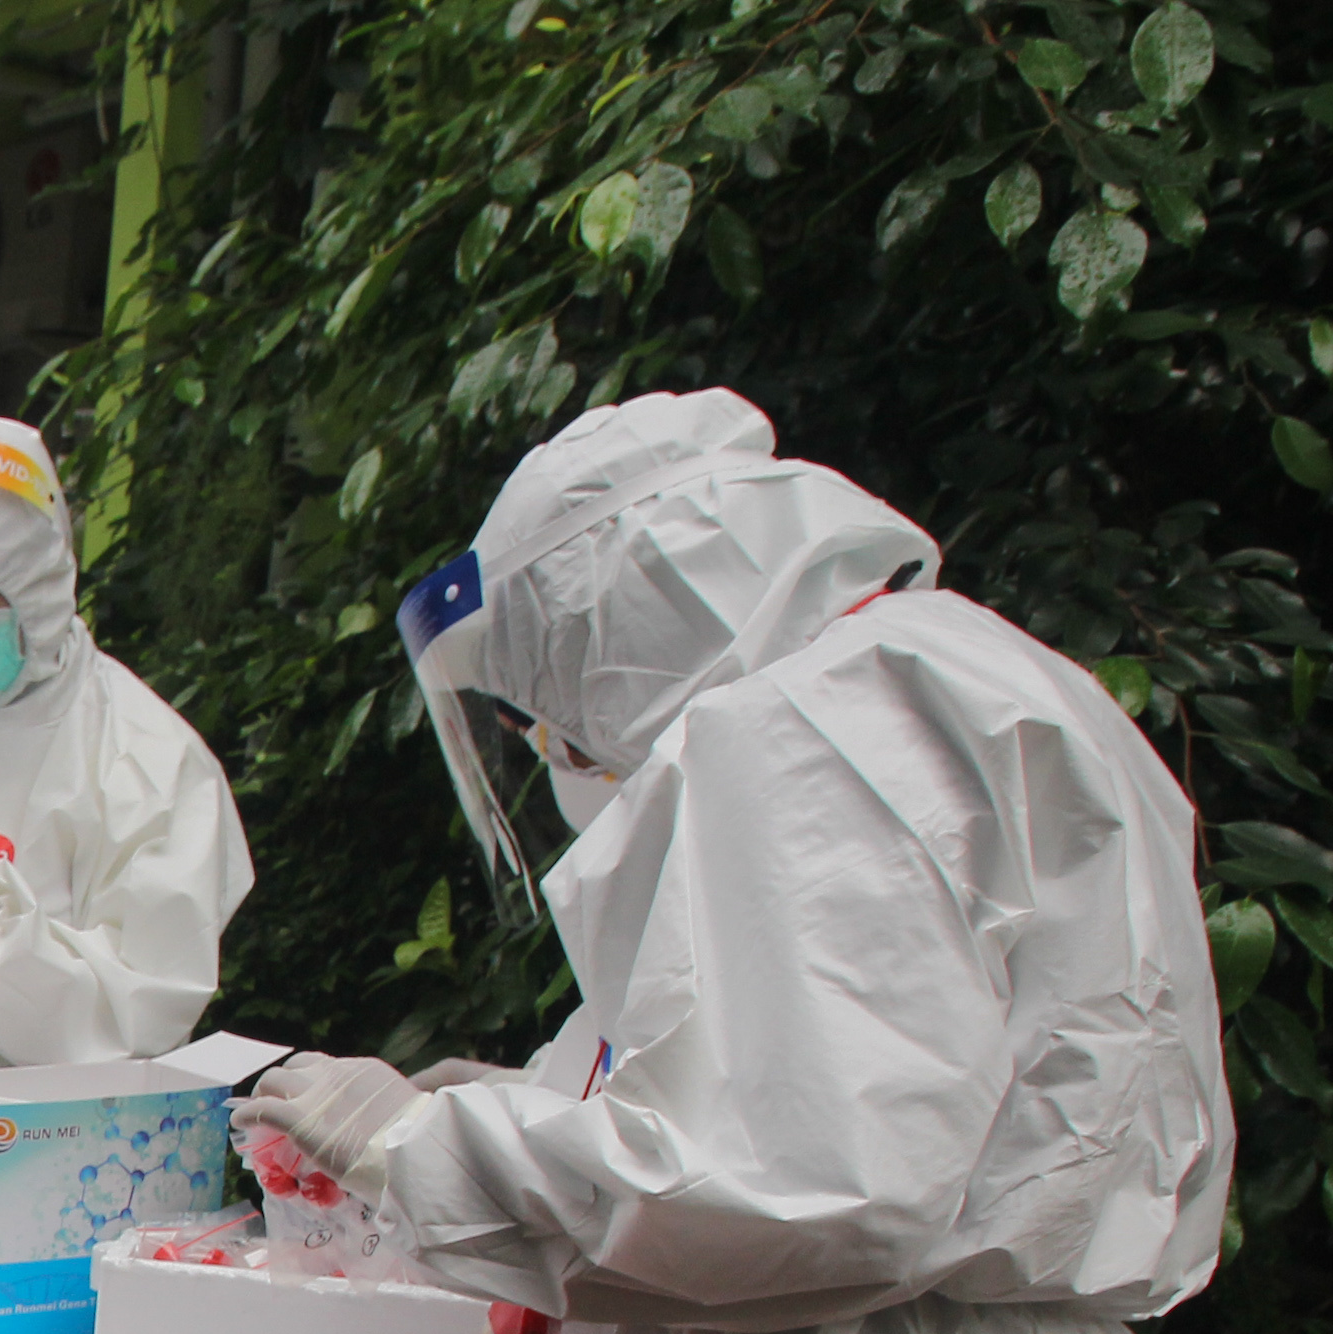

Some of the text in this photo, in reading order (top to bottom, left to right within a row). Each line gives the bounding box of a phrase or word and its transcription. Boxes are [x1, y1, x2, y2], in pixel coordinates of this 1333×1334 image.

[23, 1126, 81, 1141] RUN MEI
[15, 1301, 58, 1315] Runmei
